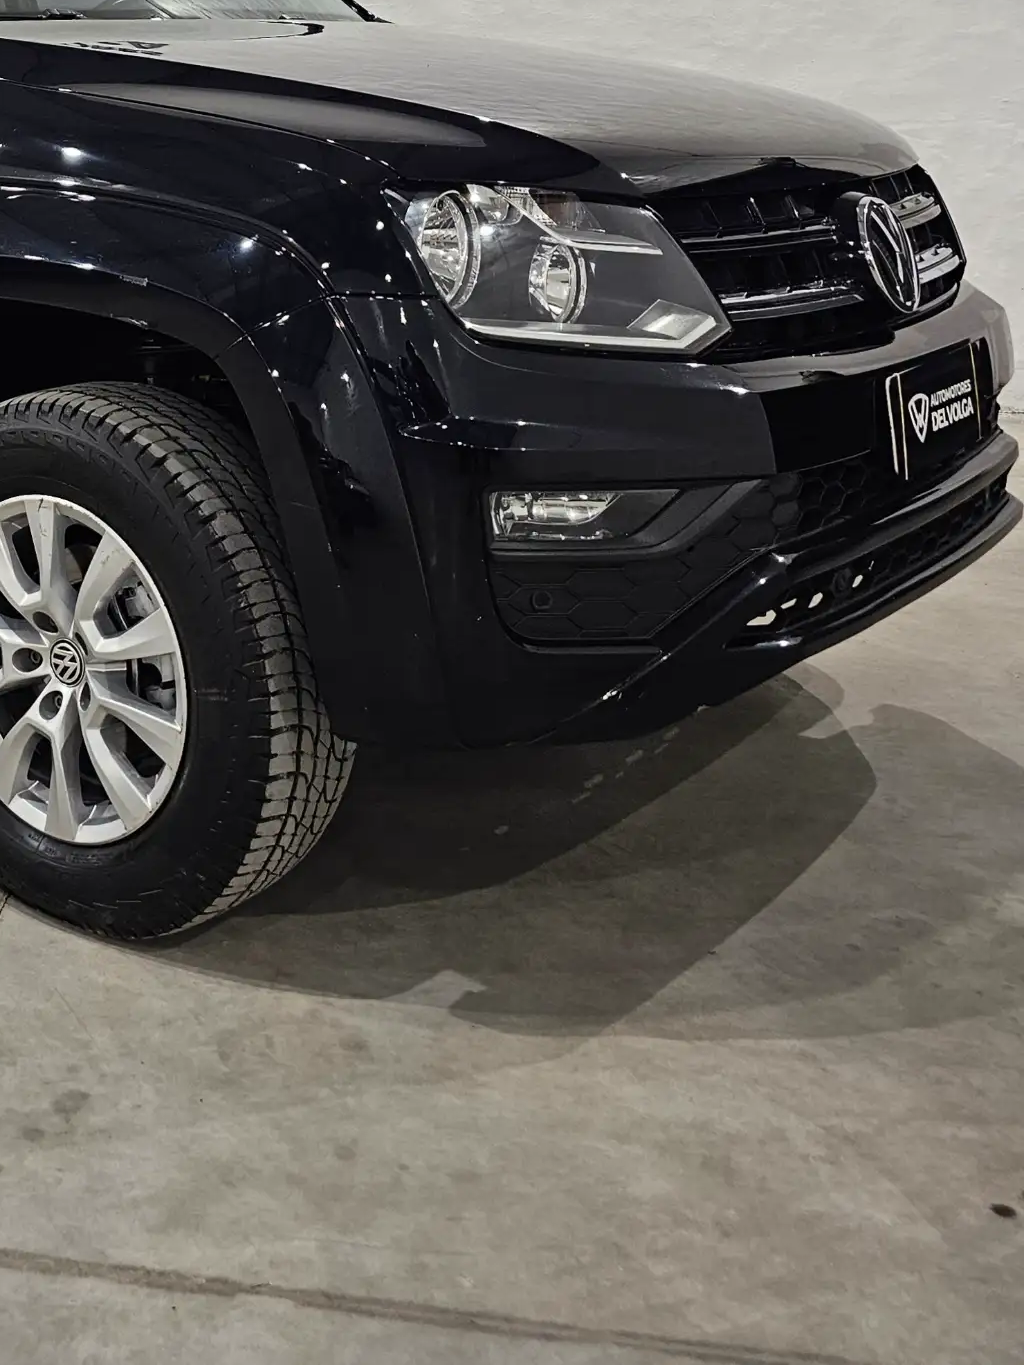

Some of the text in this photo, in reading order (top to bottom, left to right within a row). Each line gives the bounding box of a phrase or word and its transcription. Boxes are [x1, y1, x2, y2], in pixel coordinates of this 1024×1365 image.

[930, 379, 972, 407] AUTOMOTORES
[931, 396, 974, 432] DEL VOLGA
